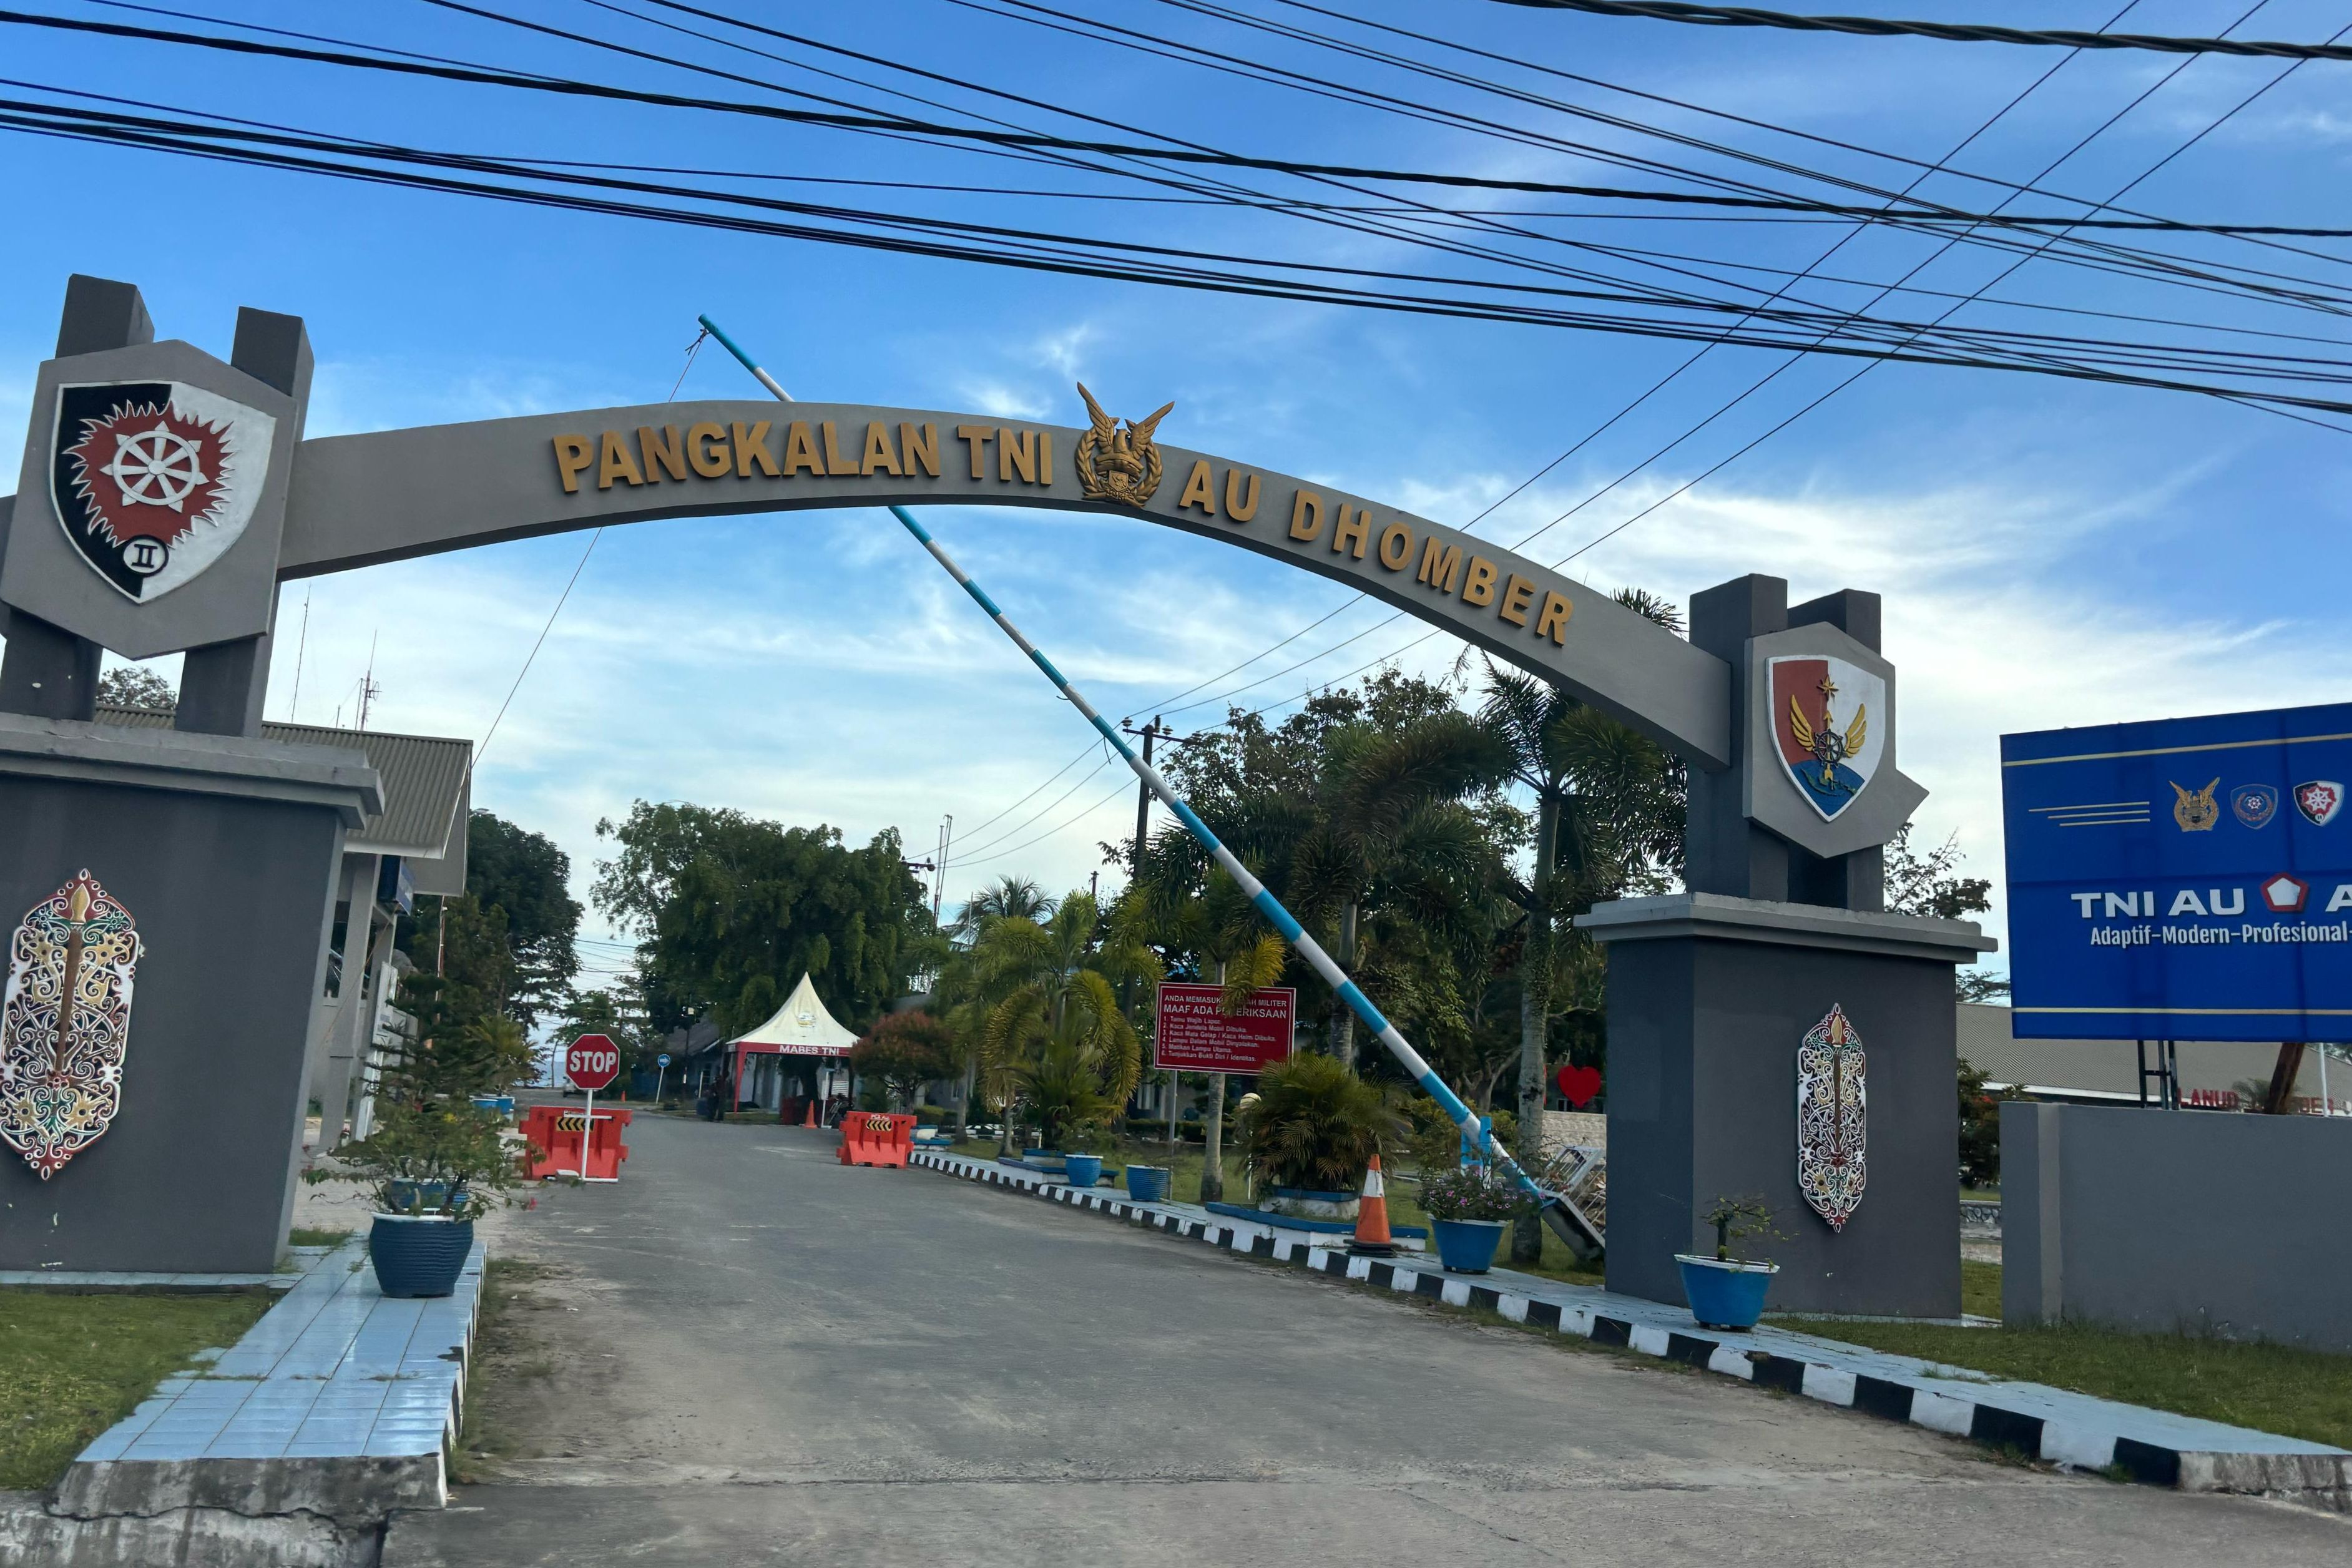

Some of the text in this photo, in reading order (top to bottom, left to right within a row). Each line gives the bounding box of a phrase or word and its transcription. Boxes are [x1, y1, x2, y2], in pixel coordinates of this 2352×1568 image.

[553, 421, 1574, 647] PANGKALAN TNI AU DHOMBER
[2071, 891, 2155, 918] TNI
[2168, 888, 2244, 916] AU
[1164, 1004, 1286, 1019] MAAF ADA PERIKSAAN
[780, 1044, 840, 1056] MABES TNI
[569, 1051, 617, 1072] STOP
